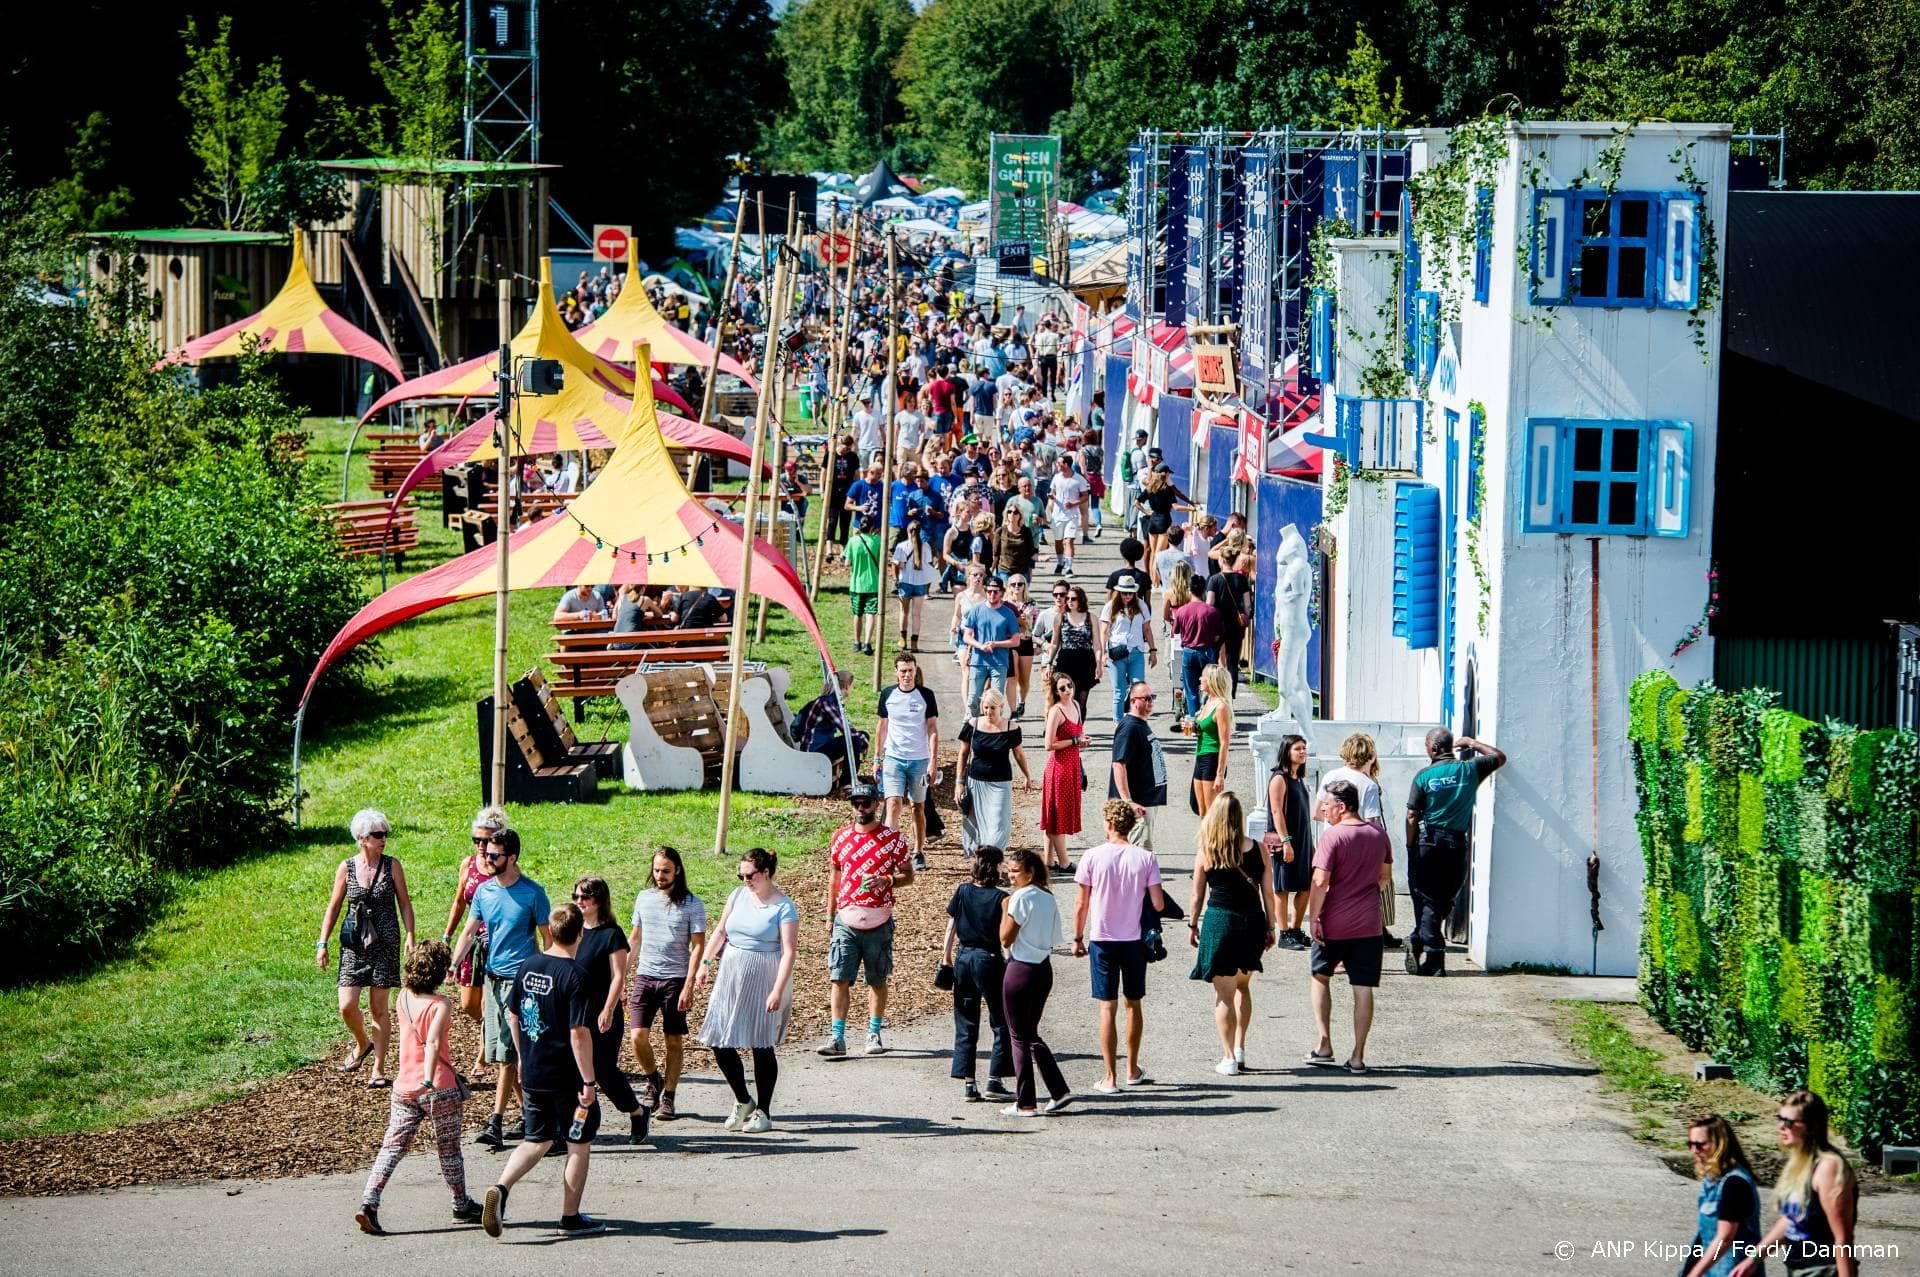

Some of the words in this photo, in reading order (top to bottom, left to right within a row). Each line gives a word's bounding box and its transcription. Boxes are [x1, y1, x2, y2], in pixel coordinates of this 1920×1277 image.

[1003, 246, 1026, 256] EXIT
[1440, 776, 1456, 784] TSC
[851, 838, 877, 862] FEBO
[851, 858, 875, 881] FEBO
